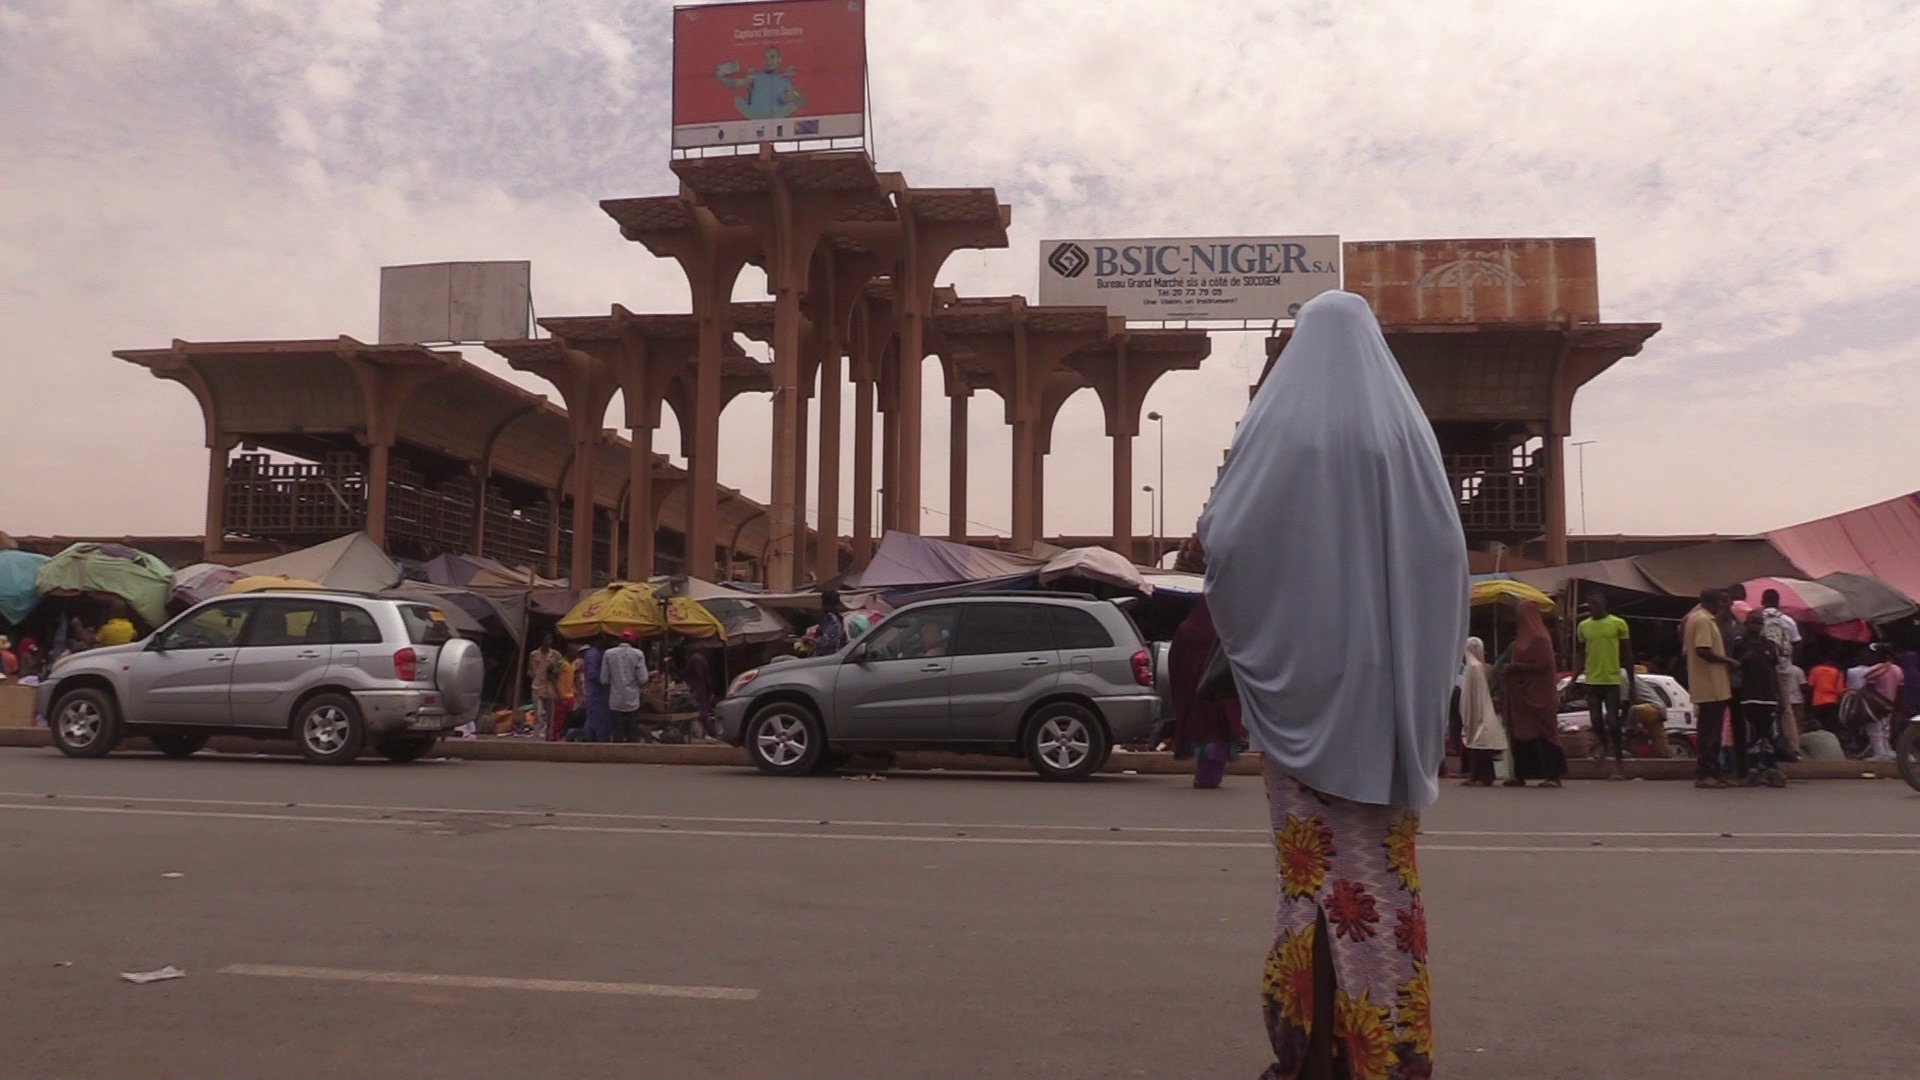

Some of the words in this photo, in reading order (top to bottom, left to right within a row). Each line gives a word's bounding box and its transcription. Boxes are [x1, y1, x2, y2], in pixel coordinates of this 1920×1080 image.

[1094, 243, 1310, 276] BSIC-NIGER
[1097, 278, 1125, 288] Bureau
[1128, 278, 1151, 288] Grand
[1154, 277, 1183, 287] Marché
[1186, 277, 1198, 287] sis
[1209, 276, 1228, 286] côté
[1231, 277, 1240, 286] de
[1244, 276, 1280, 286] SOCOGEM
